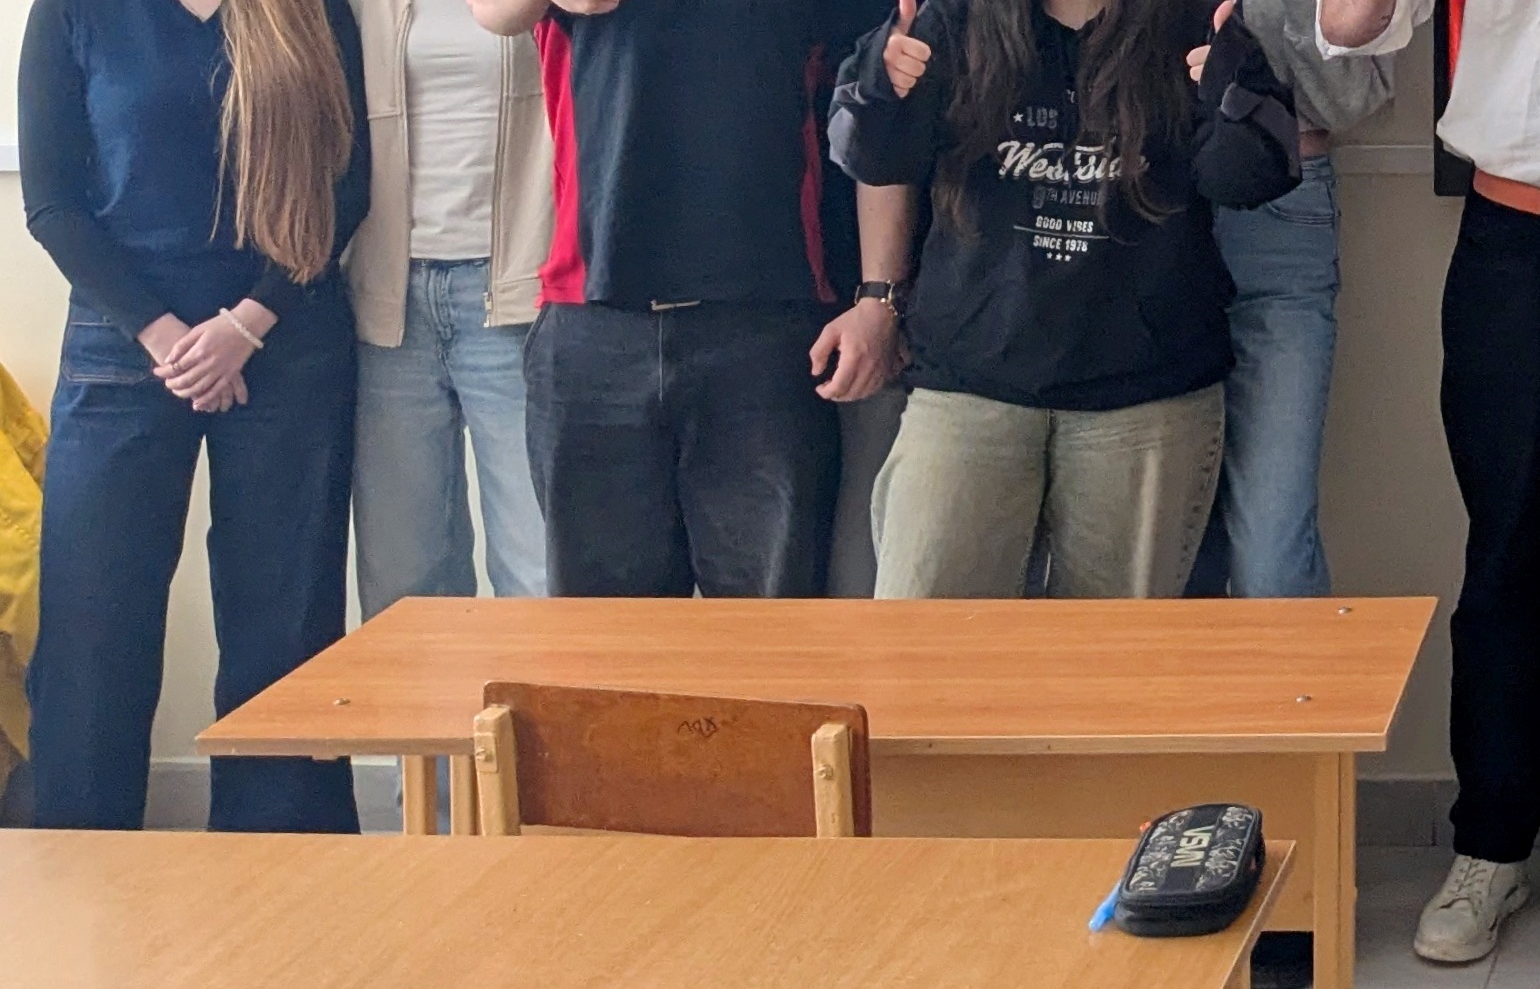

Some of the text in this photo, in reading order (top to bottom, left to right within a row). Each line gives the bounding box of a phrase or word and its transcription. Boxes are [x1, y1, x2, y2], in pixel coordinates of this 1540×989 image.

[1035, 215, 1063, 231] GOOD
[1033, 235, 1089, 252] SINCE 1978
